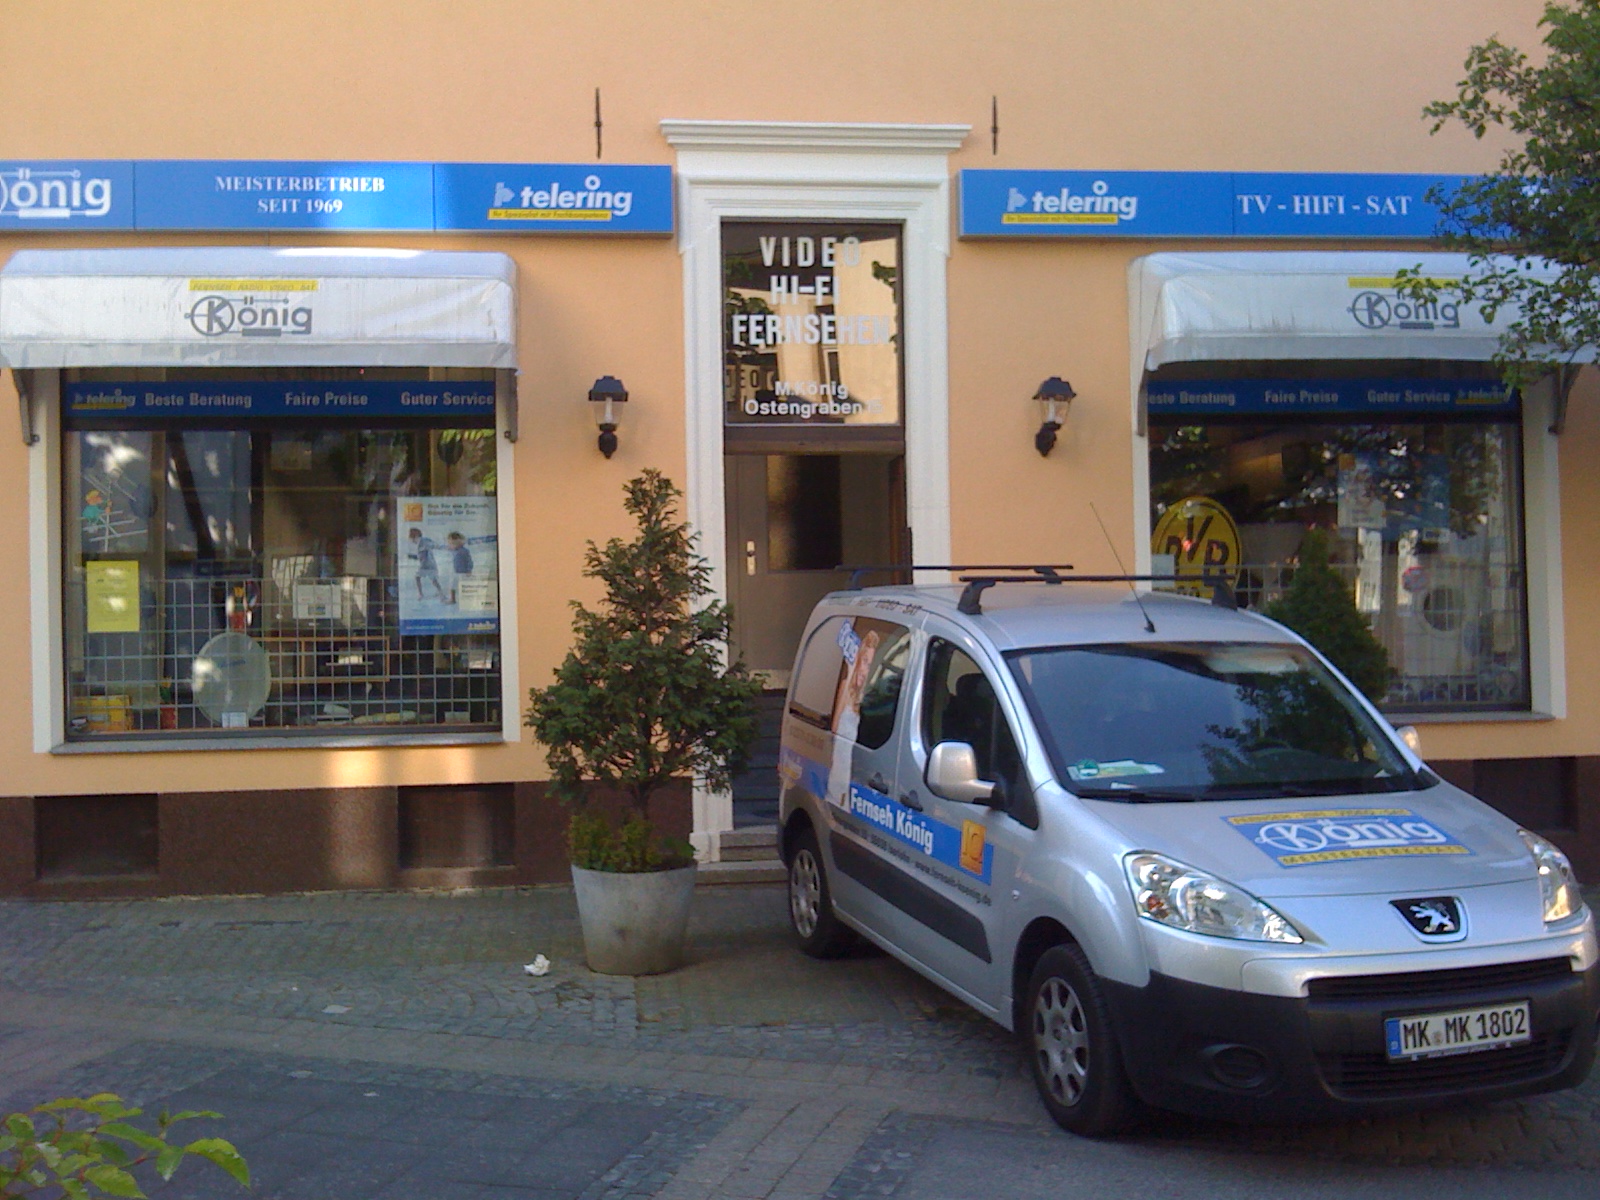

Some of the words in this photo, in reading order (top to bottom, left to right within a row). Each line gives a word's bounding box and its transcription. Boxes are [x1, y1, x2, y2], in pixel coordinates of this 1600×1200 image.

[215, 176, 385, 192] MEISTERBETRIEB
[521, 175, 632, 216] telering
[257, 198, 300, 214] SEIT
[306, 198, 343, 213] 1969
[1032, 180, 1138, 220] telering
[1237, 195, 1272, 214] TV
[1292, 195, 1345, 214] HIFI
[1366, 195, 1412, 215] SAT
[759, 236, 861, 267] VIDEO
[190, 294, 313, 336] König
[732, 315, 890, 345] FERNSEHEN
[145, 392, 184, 406] Beste
[189, 392, 252, 408] Beratung
[284, 391, 320, 406] Faire
[324, 391, 368, 406] Preise
[401, 391, 438, 405] Guter
[442, 391, 493, 405] Service
[744, 400, 863, 418] Ostengraben
[1149, 392, 1174, 405] este
[1180, 391, 1236, 406] Beratung
[1265, 390, 1296, 404] Faire
[1300, 390, 1339, 404] Preise
[1367, 389, 1400, 403] Guter
[1404, 389, 1450, 403] Service
[851, 787, 894, 830] Fernseh
[897, 808, 934, 855] König
[1258, 818, 1447, 851] König
[1403, 1020, 1431, 1050] MK
[1444, 1015, 1472, 1044] MK
[1476, 1008, 1527, 1040] 1802
